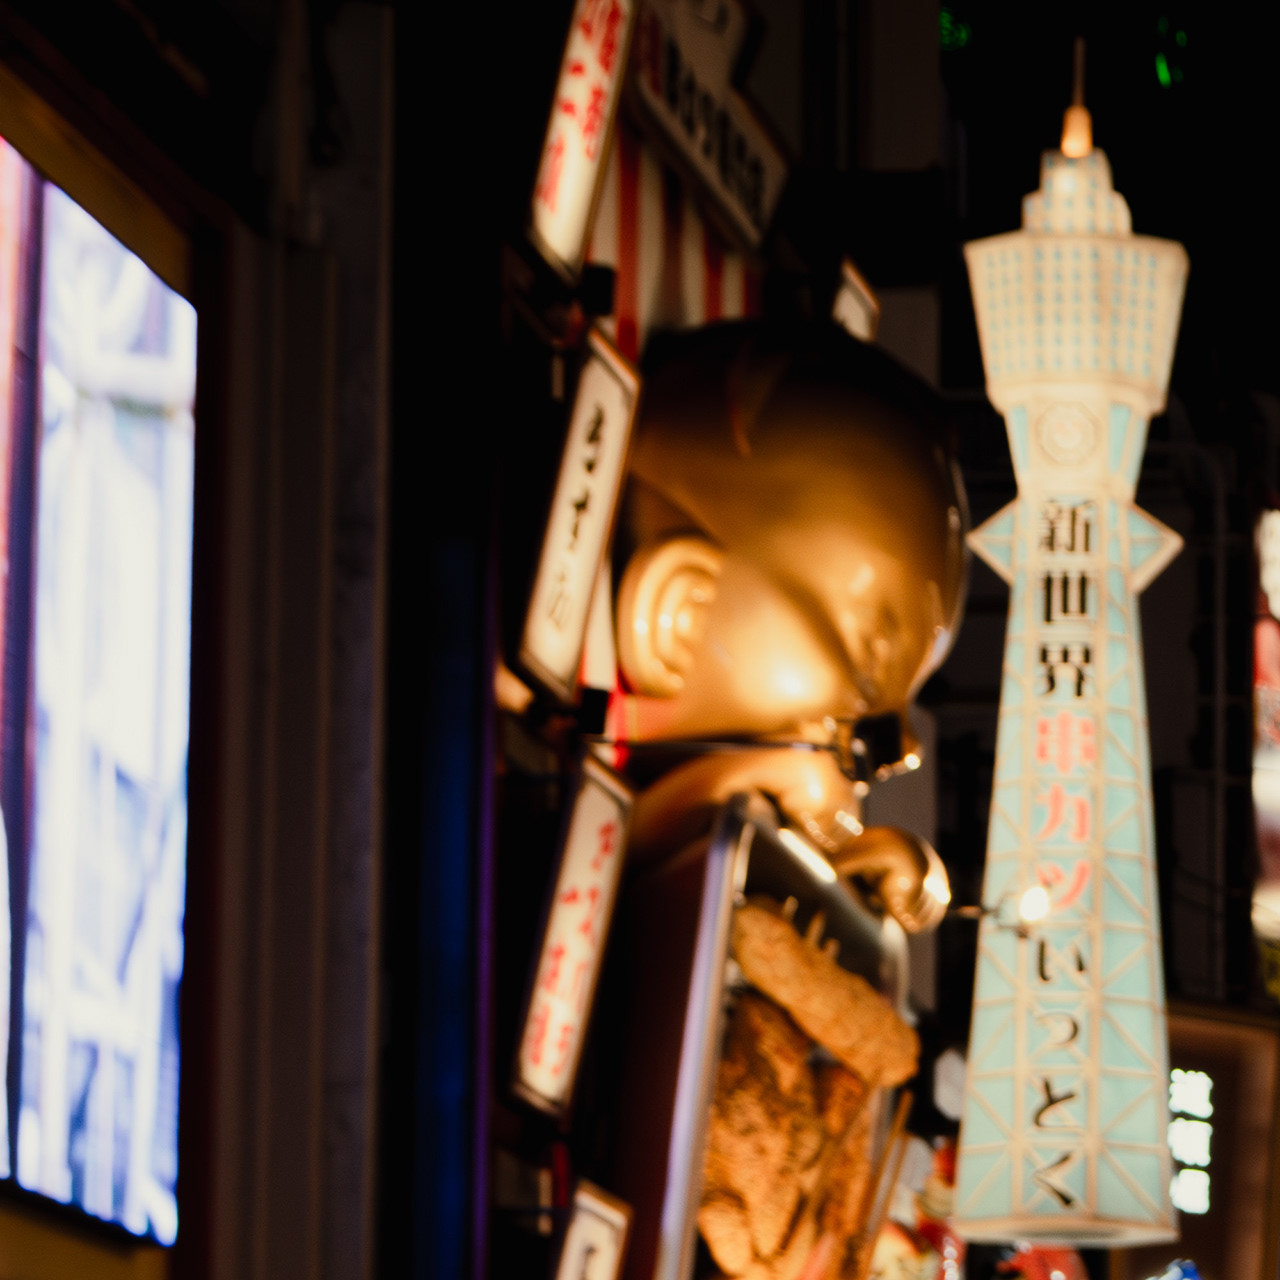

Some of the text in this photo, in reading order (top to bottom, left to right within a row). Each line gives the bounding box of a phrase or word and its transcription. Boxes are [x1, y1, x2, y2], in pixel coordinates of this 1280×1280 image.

[1034, 498, 1095, 1208] 新世界串カツいっとく
